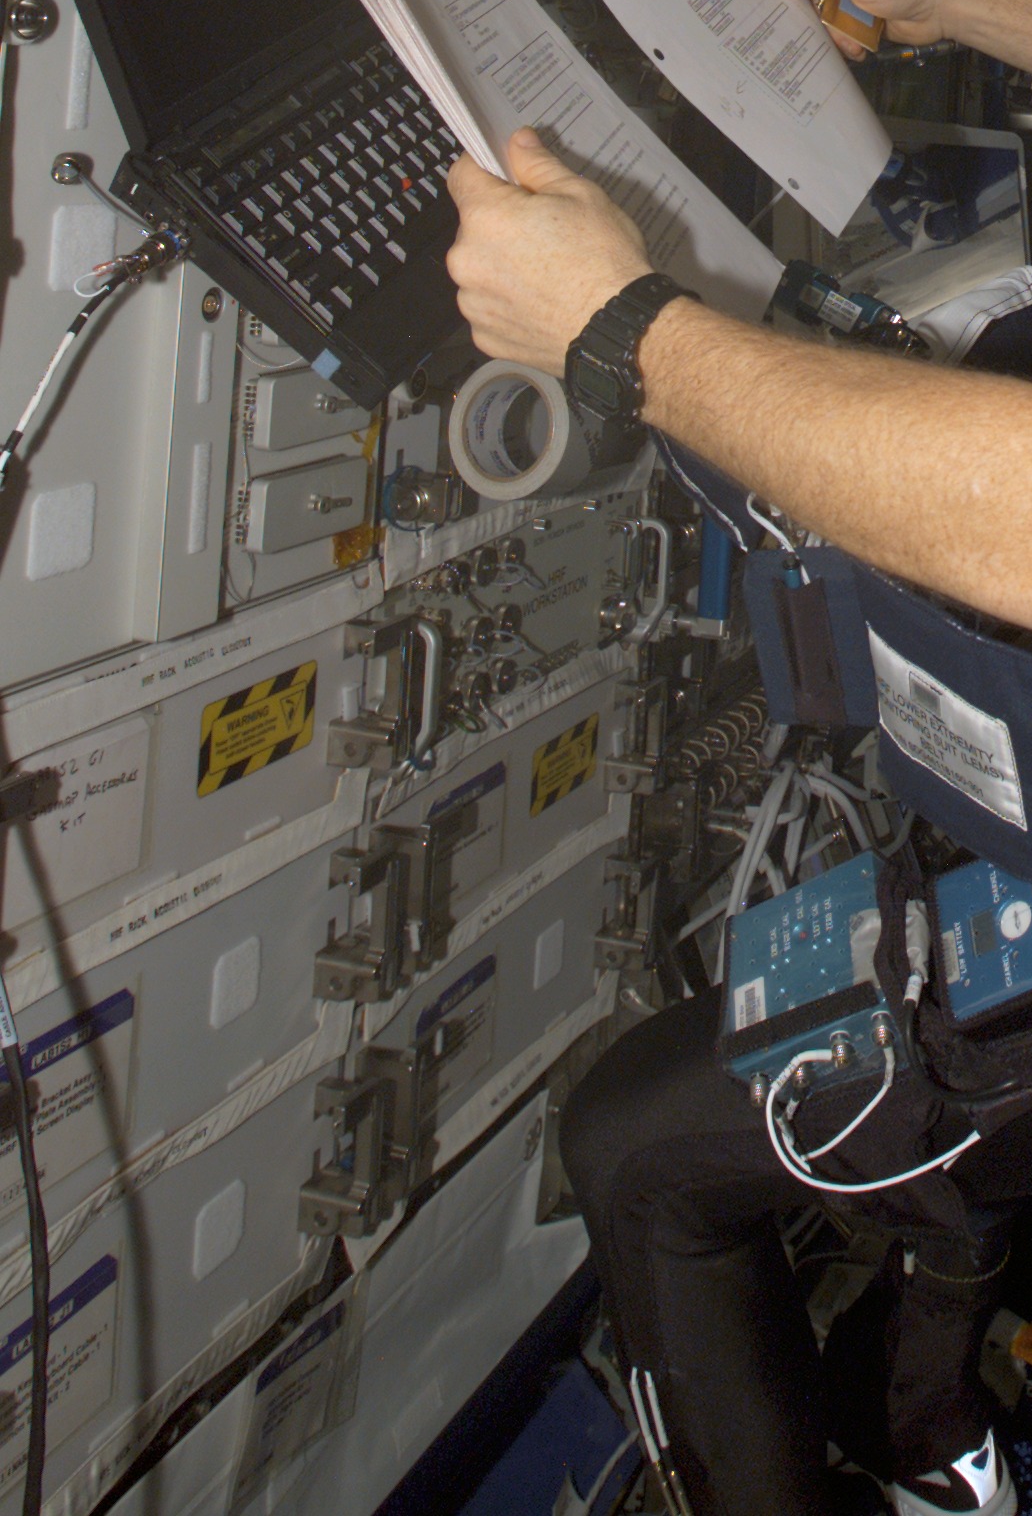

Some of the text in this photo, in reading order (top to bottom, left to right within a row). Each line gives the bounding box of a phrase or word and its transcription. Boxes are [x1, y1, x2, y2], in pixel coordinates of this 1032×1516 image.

[547, 565, 567, 586] HRF
[521, 574, 589, 618] WORKSTATION
[184, 648, 214, 669] ACOUSTIC
[226, 705, 270, 733] WARNING
[892, 691, 928, 724] LOWER
[930, 716, 994, 764] EXTREMITY
[920, 737, 945, 762] BELT
[933, 732, 957, 757] SUIT
[961, 750, 1005, 782] (LEMS)
[988, 870, 1000, 903] CHANNEL
[953, 922, 965, 956] BATTERY
[1001, 952, 1013, 987] CHANNEL
[33, 1037, 72, 1068] LAB1S2
[41, 1074, 93, 1108] Bracket Assy
[58, 1083, 96, 1111] Assembly
[36, 1113, 64, 1136] Screen
[65, 1094, 95, 1118] Display
